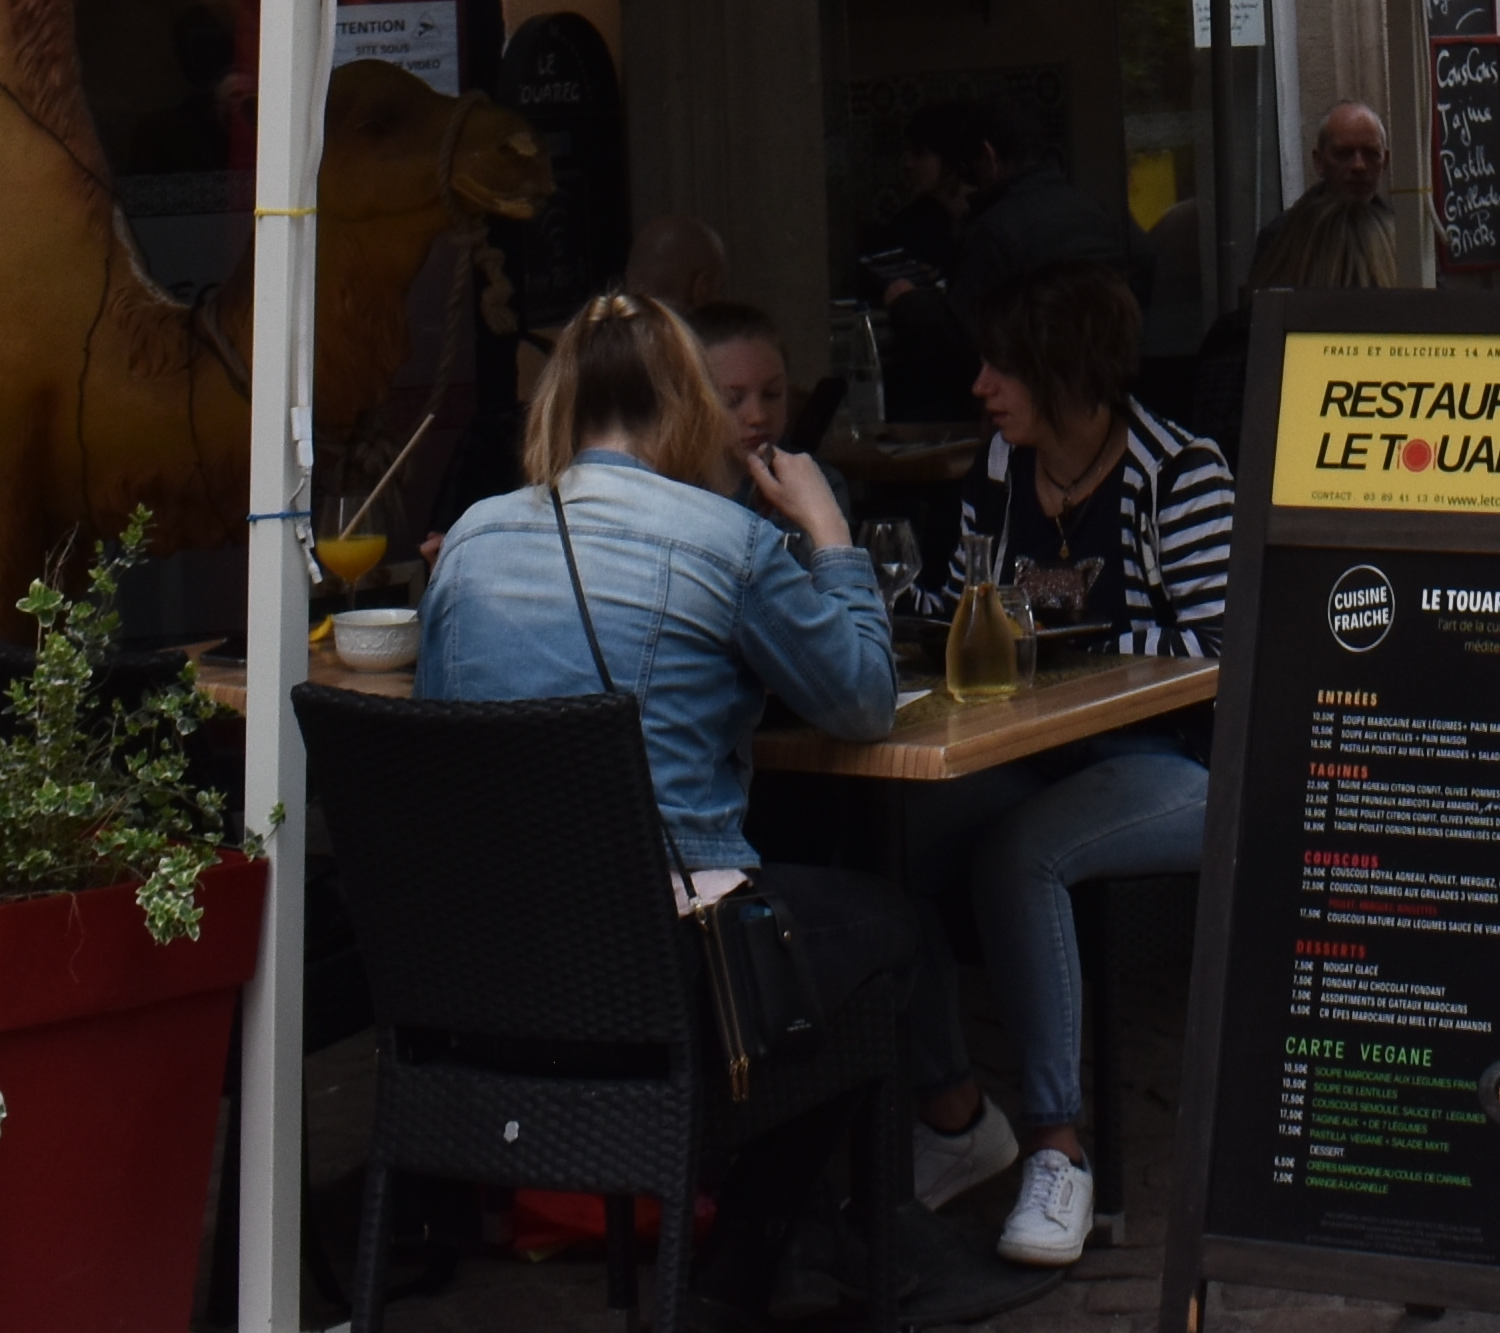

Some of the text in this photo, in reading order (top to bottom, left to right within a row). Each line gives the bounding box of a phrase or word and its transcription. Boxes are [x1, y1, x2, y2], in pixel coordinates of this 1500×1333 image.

[1322, 345, 1359, 357] FRAIS
[1367, 346, 1382, 357] ET
[1464, 347, 1479, 358] 14
[1315, 432, 1373, 471] LE
[1333, 585, 1388, 611] CUISINE
[1420, 587, 1442, 612] LE
[1333, 607, 1391, 634] FRAICHE
[1460, 619, 1473, 633] de
[1317, 689, 1378, 707] ENTRÉES
[1310, 762, 1369, 780] TAGINES
[1304, 849, 1378, 867] COUSCOUS
[1295, 939, 1367, 960] DESSERTS
[1323, 961, 1353, 975] NOUGAT
[1322, 975, 1357, 989] FONDANT
[1370, 979, 1409, 994] CHOCOLAT
[1411, 983, 1446, 998] FONDANT
[1285, 1036, 1433, 1067] CARTE VEGANE
